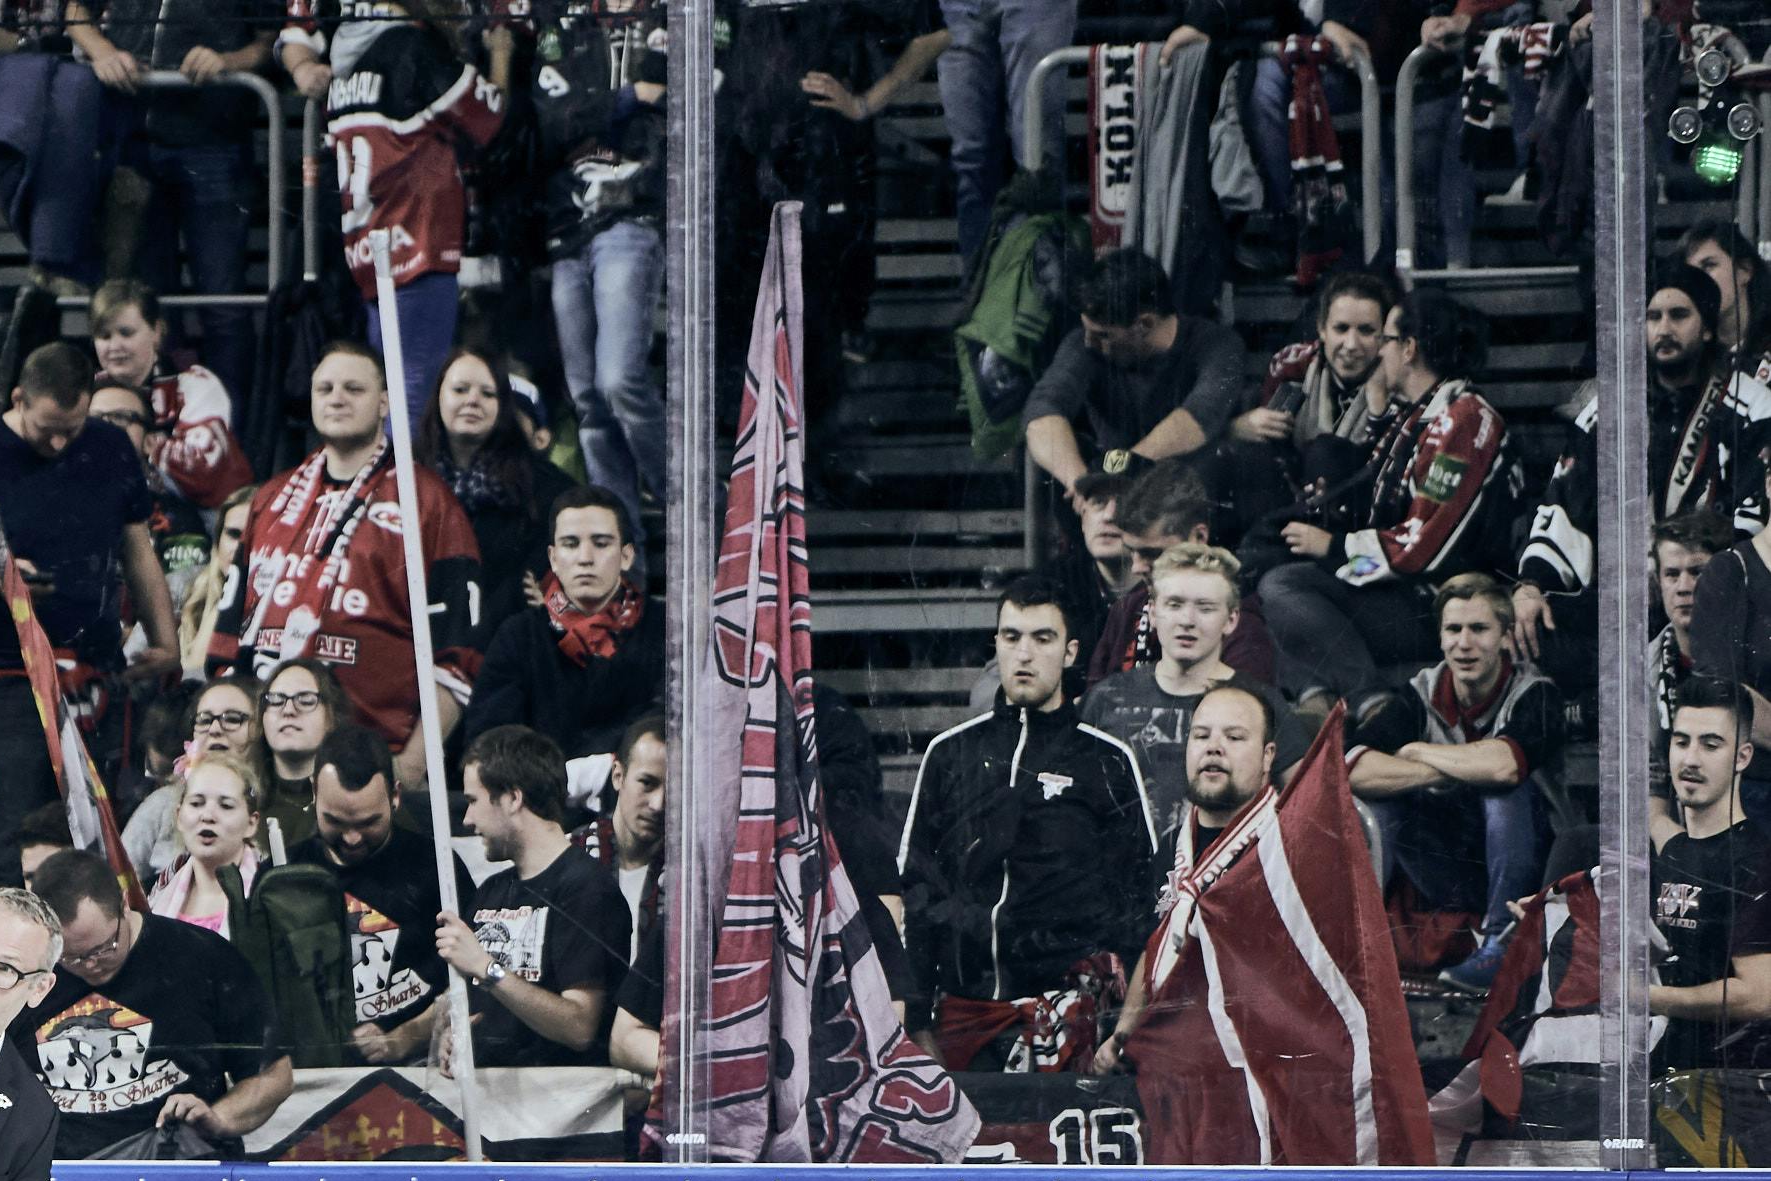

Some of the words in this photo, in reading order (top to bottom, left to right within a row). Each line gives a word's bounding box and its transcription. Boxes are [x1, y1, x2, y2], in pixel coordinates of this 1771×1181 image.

[317, 636, 356, 661] AIE
[361, 979, 422, 1018] Sharks
[113, 1069, 180, 1107] Sharks
[91, 1102, 107, 1112] 12
[674, 1132, 706, 1145] RAITA
[1050, 1108, 1144, 1165] 15
[1612, 1138, 1645, 1149] RAITA
